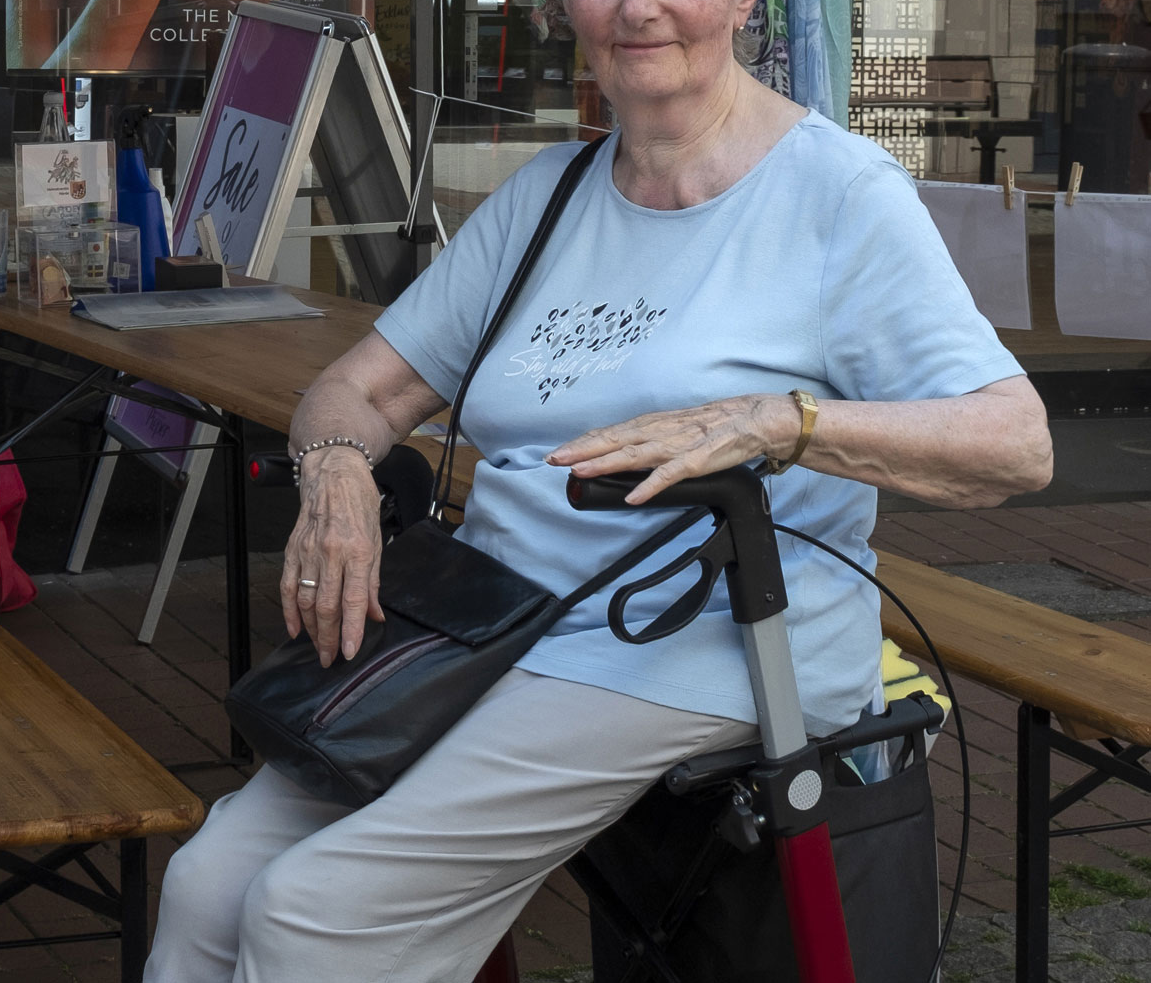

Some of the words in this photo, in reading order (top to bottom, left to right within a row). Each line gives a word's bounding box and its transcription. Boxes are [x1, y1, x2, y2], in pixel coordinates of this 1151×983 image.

[183, 9, 219, 23] THE
[150, 28, 222, 42] COLLE
[203, 119, 259, 213] Sale
[504, 347, 548, 377] Stay
